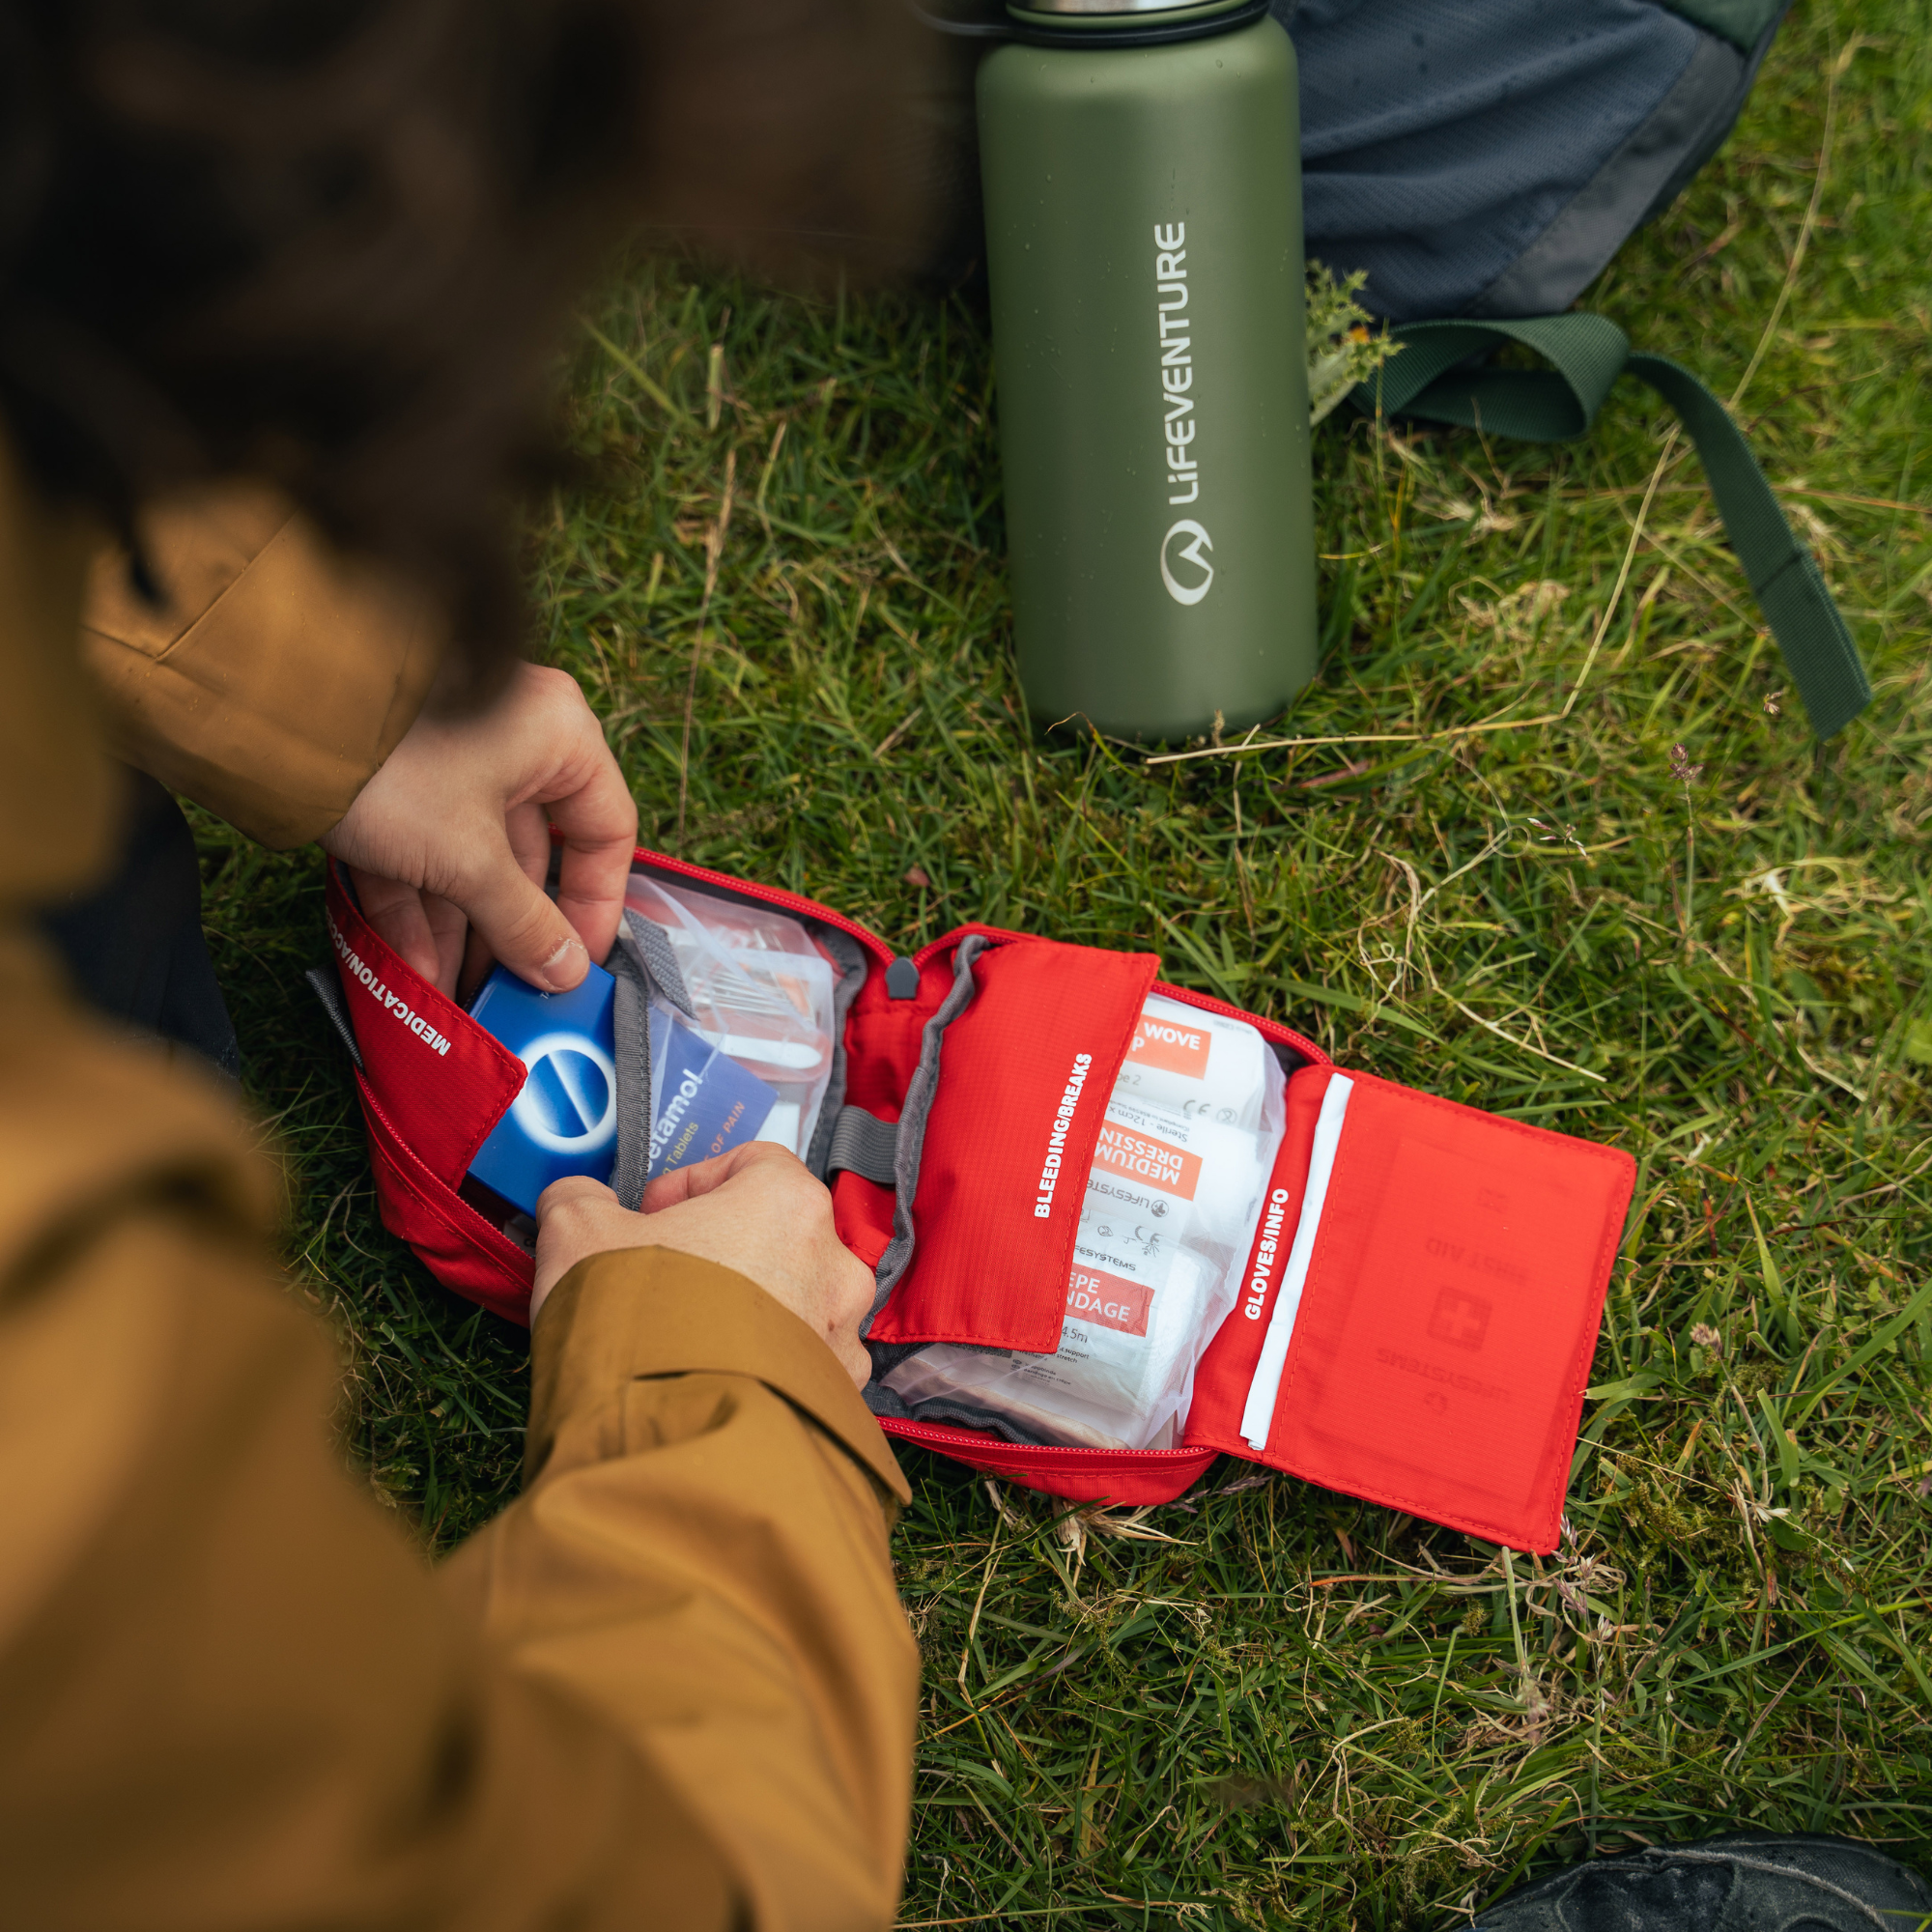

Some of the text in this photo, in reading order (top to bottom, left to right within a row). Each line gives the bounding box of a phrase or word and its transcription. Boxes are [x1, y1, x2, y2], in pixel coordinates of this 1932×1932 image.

[1144, 1022, 1201, 1050] WOVE
[711, 1100, 746, 1154] OF PAIN
[1034, 1053, 1093, 1219] BLEEDING/BREAKS
[1117, 1109, 1147, 1126] 12cm
[1156, 1122, 1188, 1143] Sterile
[665, 1122, 699, 1165] Tablets
[1094, 1141, 1180, 1185] MEDIUM
[1099, 1126, 1184, 1171] DRESSIN
[1244, 1188, 1289, 1321] GLOVES/INFO
[1056, 1353, 1078, 1364] stretch
[1065, 1348, 1090, 1360] support
